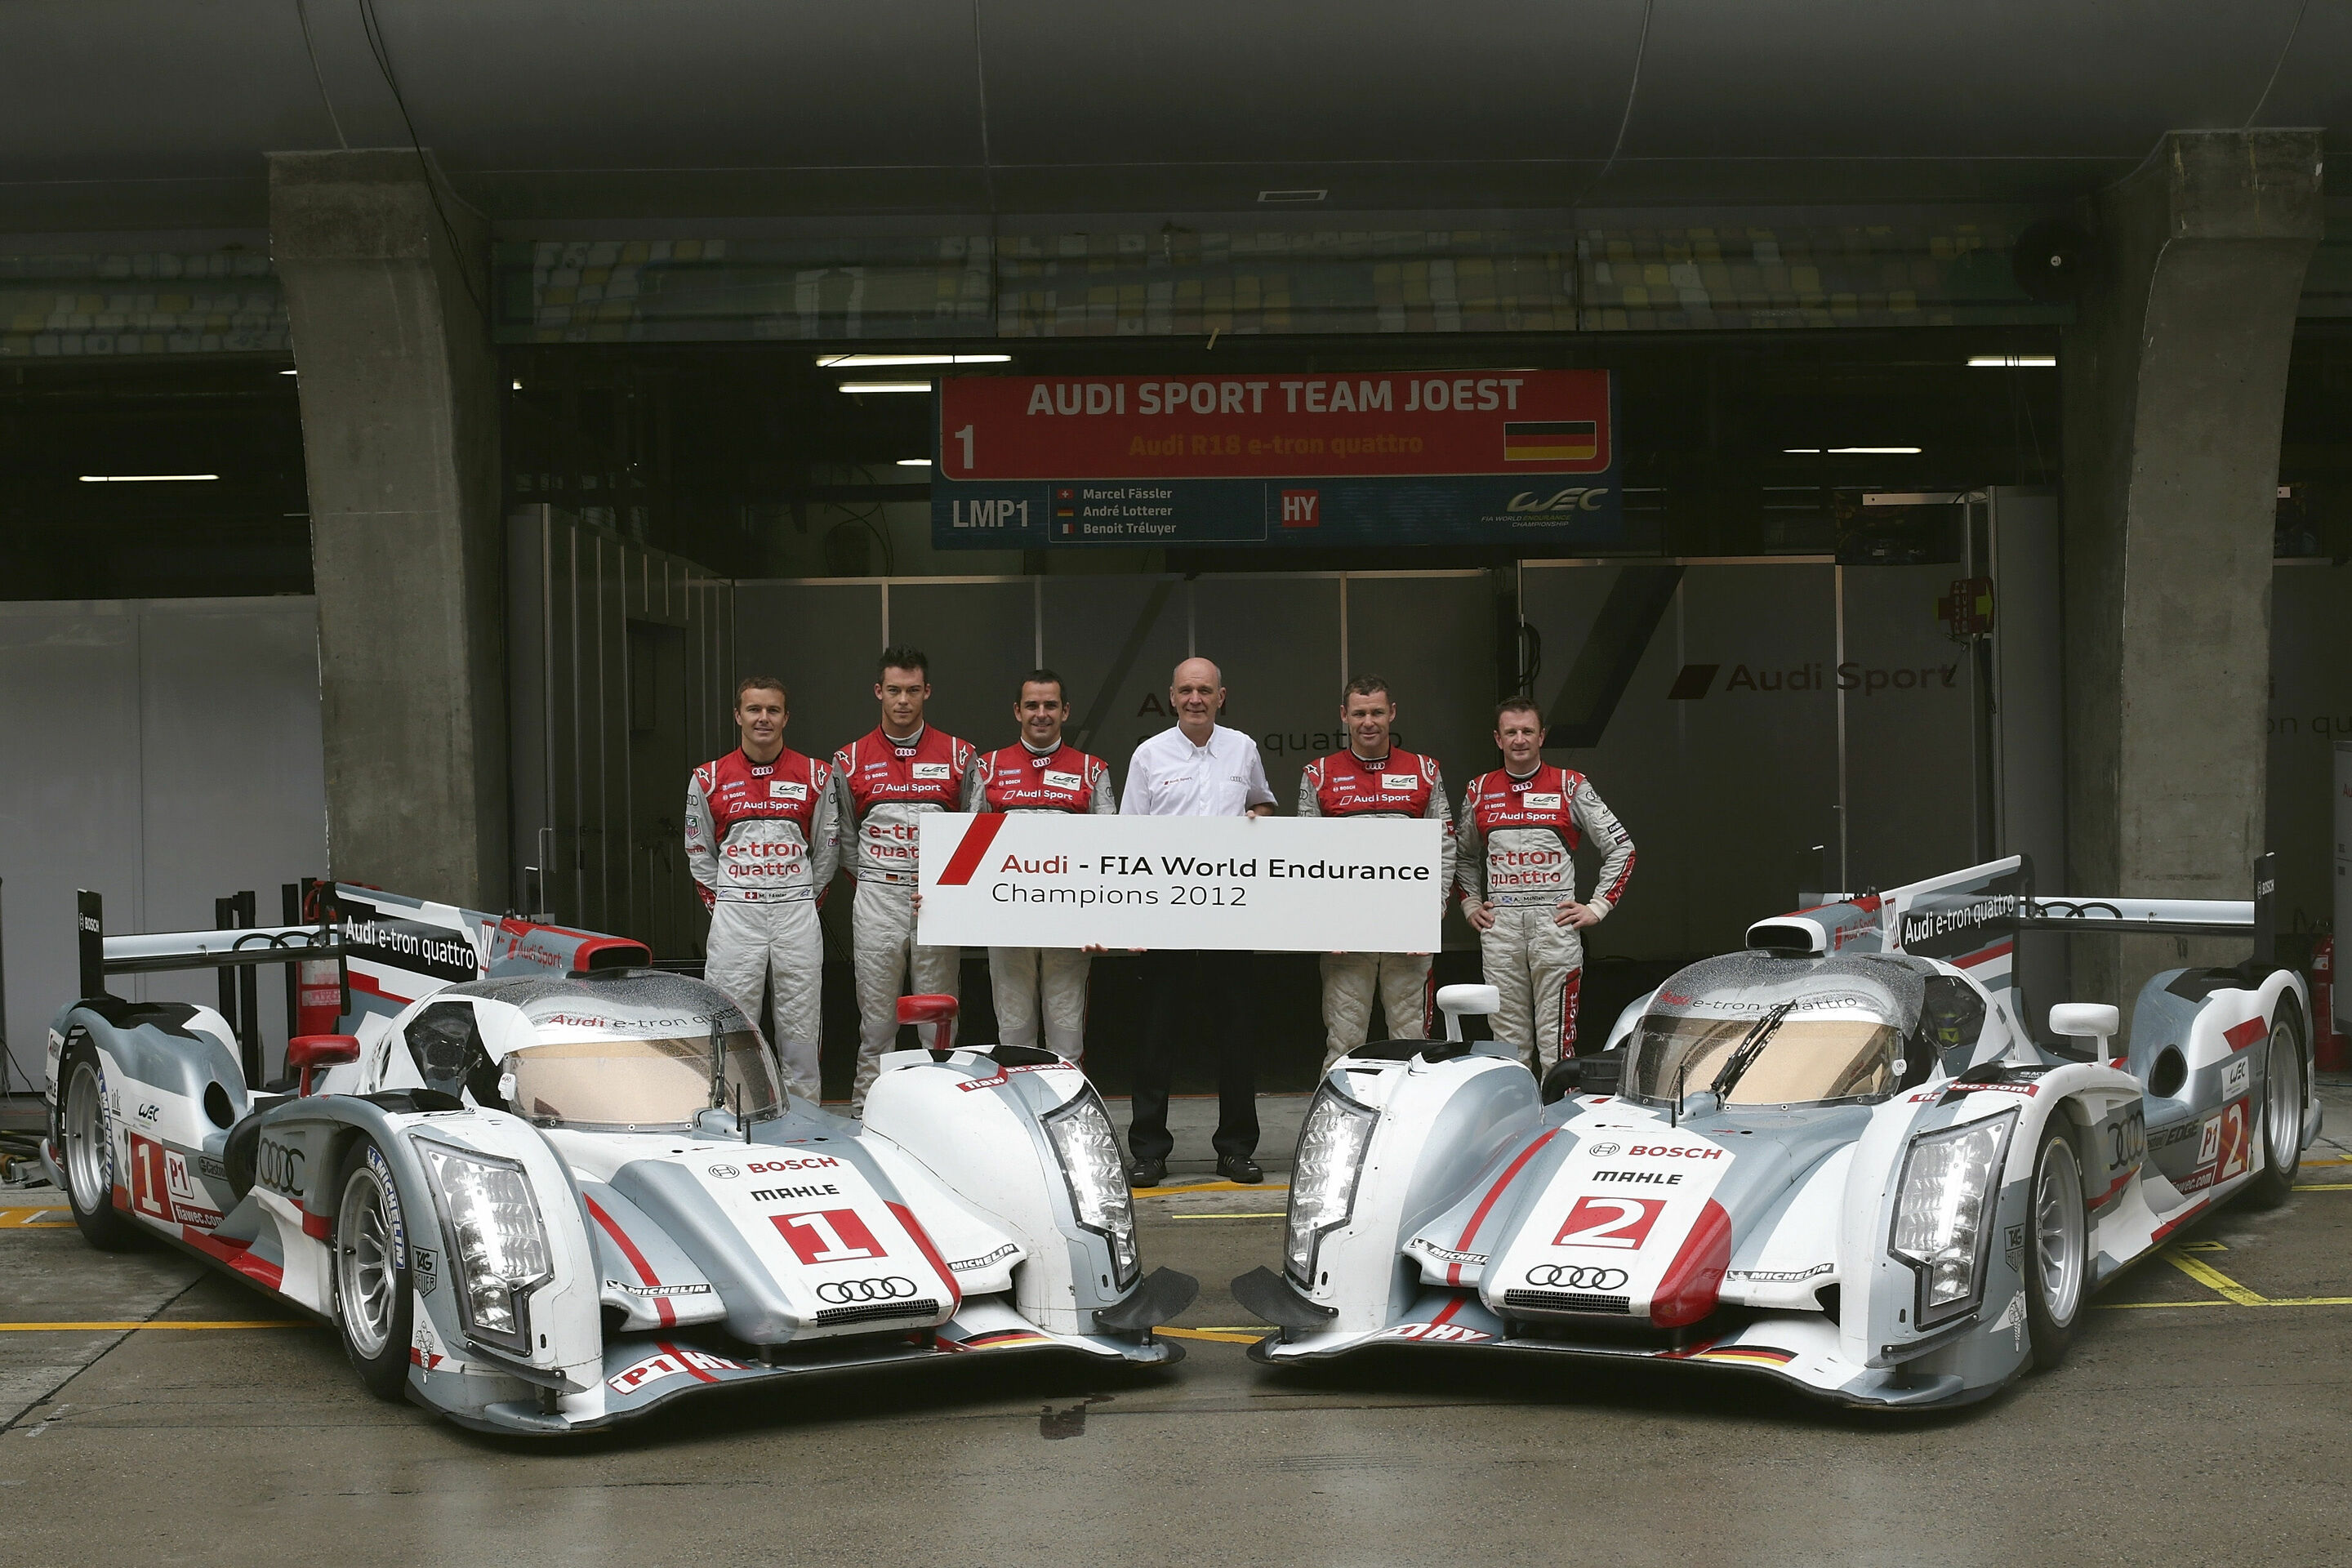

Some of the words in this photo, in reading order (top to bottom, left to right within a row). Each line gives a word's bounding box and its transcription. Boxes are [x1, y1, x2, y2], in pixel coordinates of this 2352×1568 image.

[1027, 383, 1125, 415] AUDI
[1138, 381, 1268, 414] SPORT
[1280, 380, 1392, 412] TEAM
[1405, 379, 1523, 412] JOEST
[955, 425, 974, 469] 1
[1129, 434, 1183, 456] Audi
[1192, 434, 1240, 455] R18
[1248, 434, 1323, 454] e-tron
[1331, 434, 1423, 458] quattro
[1083, 488, 1125, 500] Marcel
[1129, 488, 1172, 500] Fässler
[1507, 488, 1609, 512] WEC
[953, 499, 1029, 528] LMP1
[1083, 504, 1120, 517] André
[1122, 505, 1173, 517] Lotterer
[1283, 496, 1317, 521] HY
[1084, 523, 1123, 535] Benoit
[1125, 521, 1177, 537] Tréluyer
[1726, 665, 1823, 692] Audi
[1837, 662, 1958, 696] Sport
[885, 783, 909, 792] Audi
[911, 783, 942, 793] Sport
[1016, 790, 1041, 798] Audi
[1045, 790, 1073, 800] Sport
[1353, 794, 1379, 803] Audi
[1381, 794, 1410, 804] Sport
[743, 801, 767, 809] Audi
[769, 801, 799, 811] Sport
[1499, 812, 1524, 820] Audi
[1526, 812, 1557, 822] Sport
[868, 823, 920, 840] e-tr
[727, 841, 803, 858] e-tron
[869, 844, 920, 858] quat
[1490, 850, 1561, 866] e-tron
[728, 862, 801, 879] quattro
[1000, 853, 1068, 875] Audi
[1099, 856, 1153, 875] FIA
[1160, 856, 1258, 879] World
[1268, 858, 1430, 881] Endurance
[1490, 871, 1561, 887] quattro
[992, 882, 1159, 909] Champions
[1170, 884, 1247, 906] 2012
[85, 915, 100, 933] BOSCH
[1904, 911, 1934, 945] Audi
[1936, 905, 1971, 936] e-tron
[1973, 893, 2015, 925] quattro
[345, 915, 376, 946] Audi
[378, 928, 419, 956] e-tron
[421, 938, 474, 970] quattro
[518, 942, 537, 960] Audi
[537, 945, 562, 970] Sport
[1693, 999, 1760, 1011] e-tron
[549, 1013, 604, 1027] Audi
[612, 1018, 688, 1028] e-tron
[2230, 1062, 2246, 1085] WEC
[138, 1102, 160, 1122] WEC
[100, 1092, 112, 1194] MICHELIN
[2165, 1118, 2199, 1147] EDGE
[2202, 1123, 2218, 1158] P1
[2221, 1103, 2243, 1179] 2
[1628, 1145, 1723, 1160] BOSCH
[169, 1157, 188, 1191] P1
[746, 1157, 840, 1174] BOSCH
[138, 1143, 162, 1214] 1
[1592, 1170, 1683, 1185] MAHLE
[750, 1184, 840, 1201] MAHLE
[176, 1205, 224, 1227] fiawec.com
[376, 1159, 404, 1267] MICHELIN
[1560, 1197, 1646, 1248] 2
[787, 1211, 873, 1262] 1
[415, 1250, 433, 1272] TAG
[951, 1243, 1015, 1272] MICHELIN
[1748, 1263, 1833, 1281] MICHELIN
[626, 1284, 708, 1296] MICHELIN
[1422, 1324, 1490, 1342] HY
[621, 1359, 675, 1386] P1
[679, 1351, 742, 1370] HY
